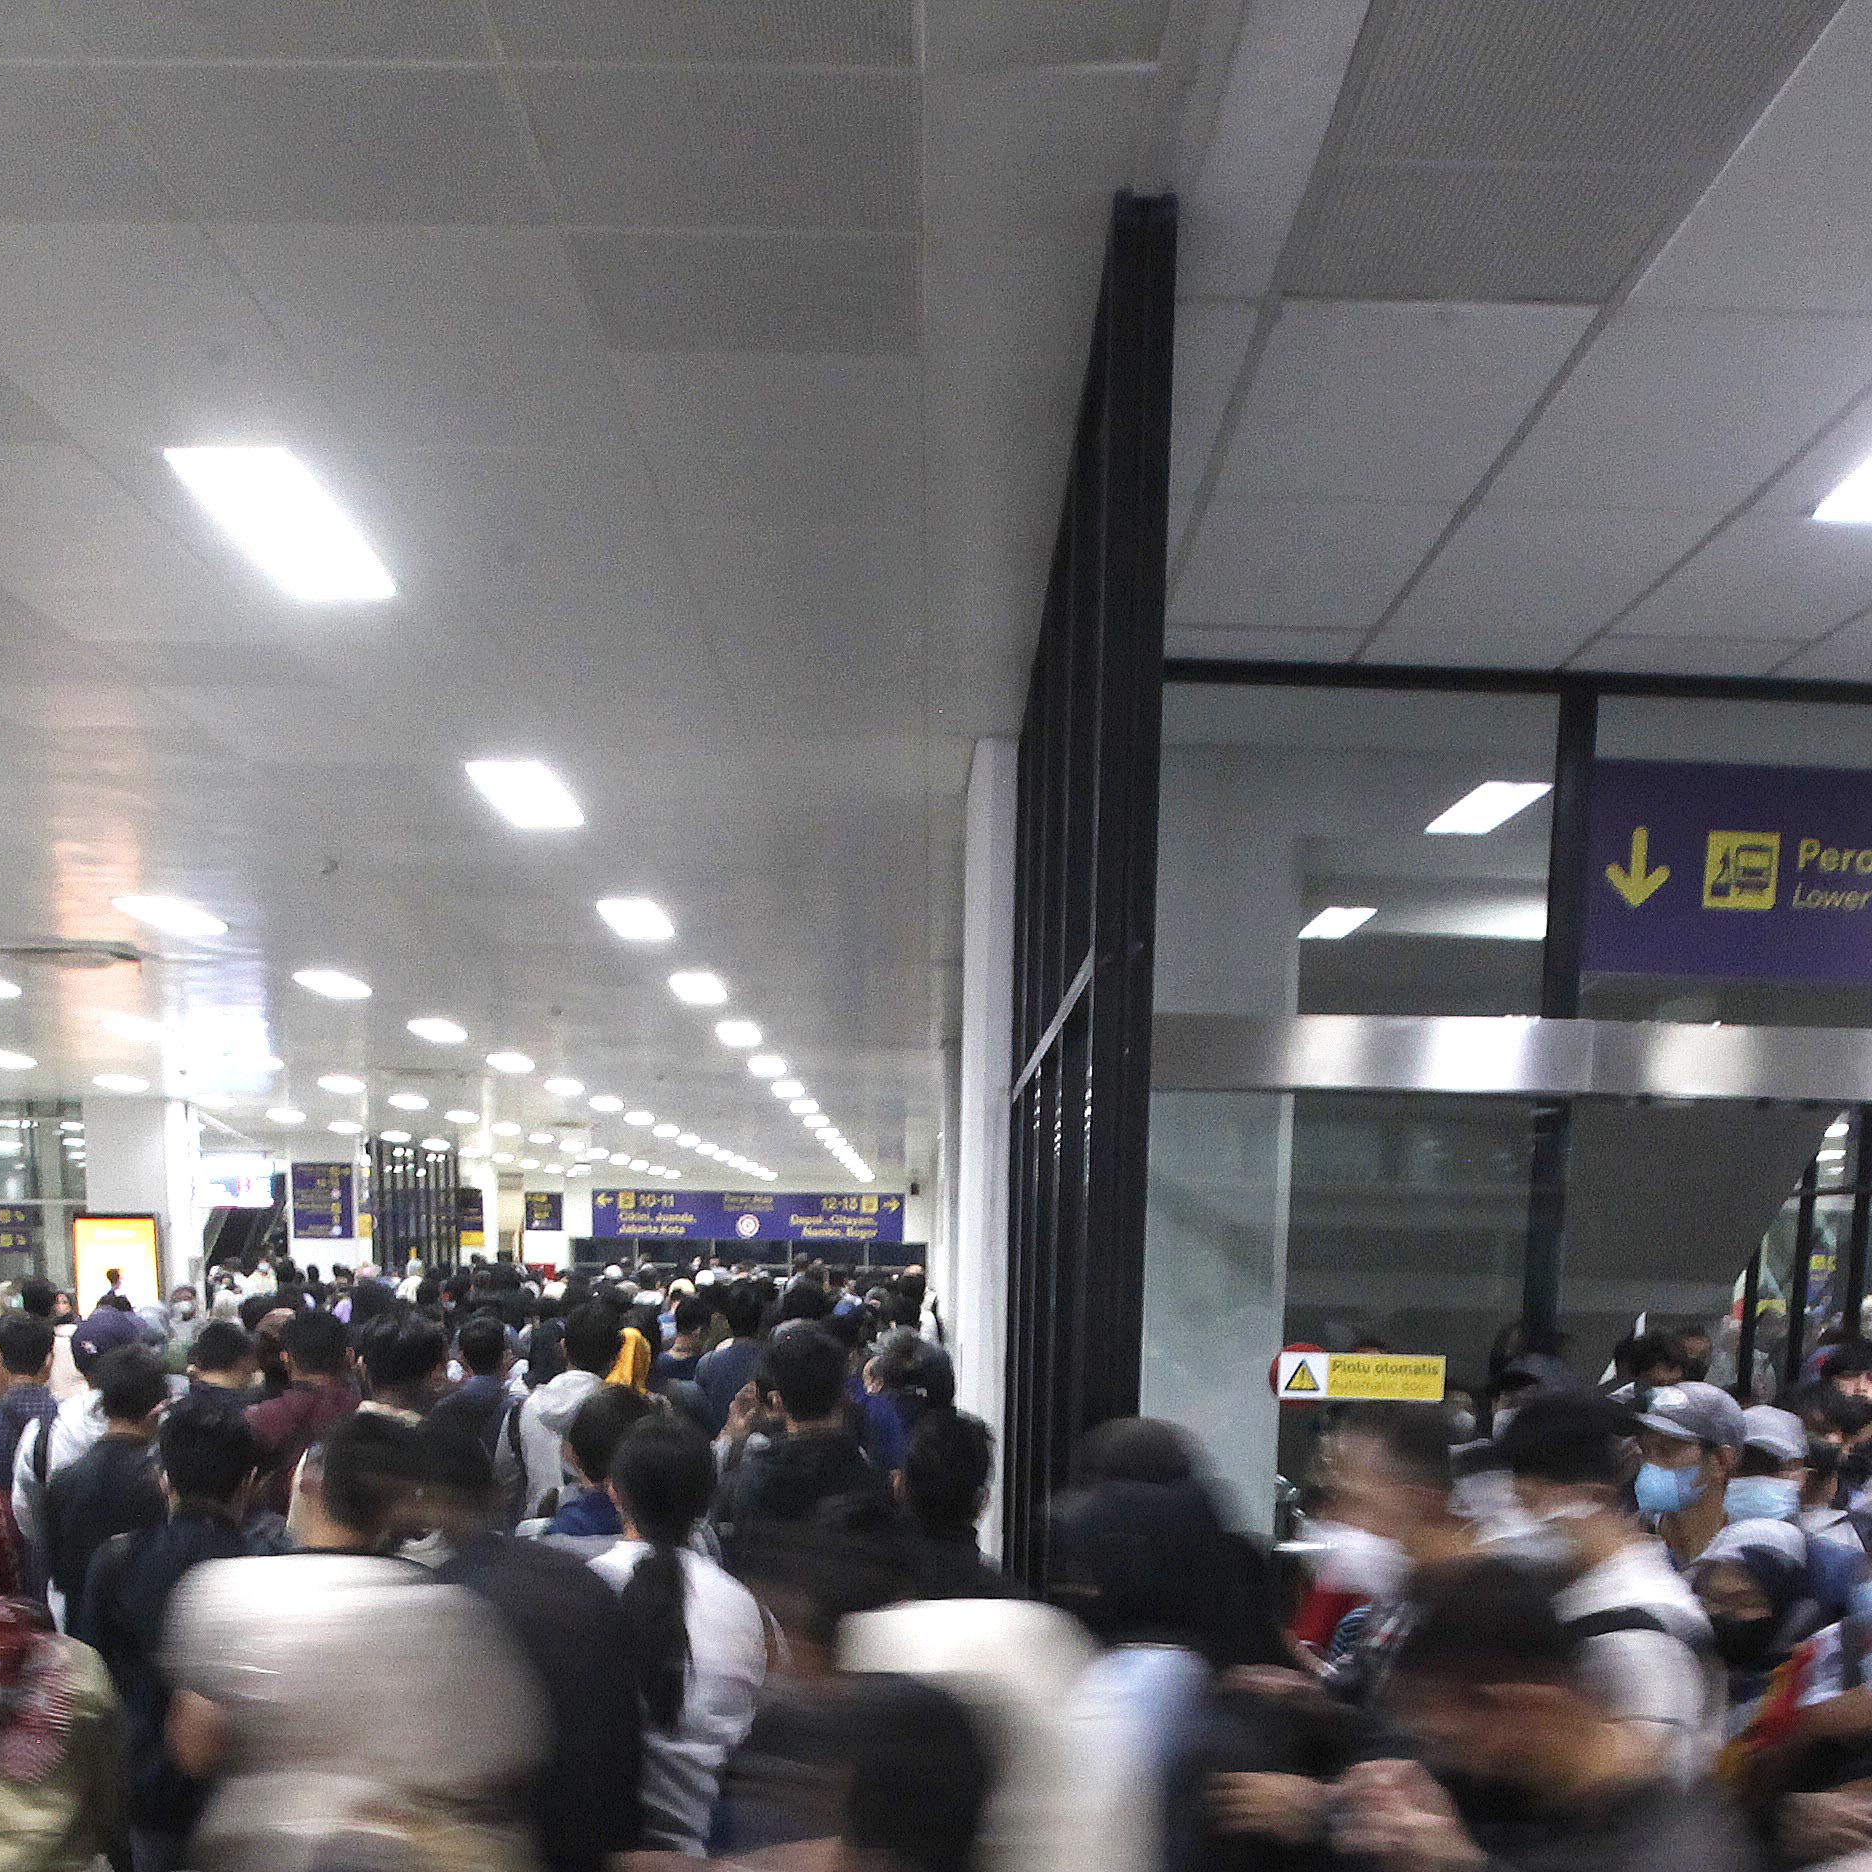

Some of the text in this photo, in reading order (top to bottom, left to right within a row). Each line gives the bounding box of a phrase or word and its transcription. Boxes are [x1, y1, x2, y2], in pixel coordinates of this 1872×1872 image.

[1792, 882, 1872, 910] Lower
[1332, 1360, 1439, 1377] Pintu otomatis
